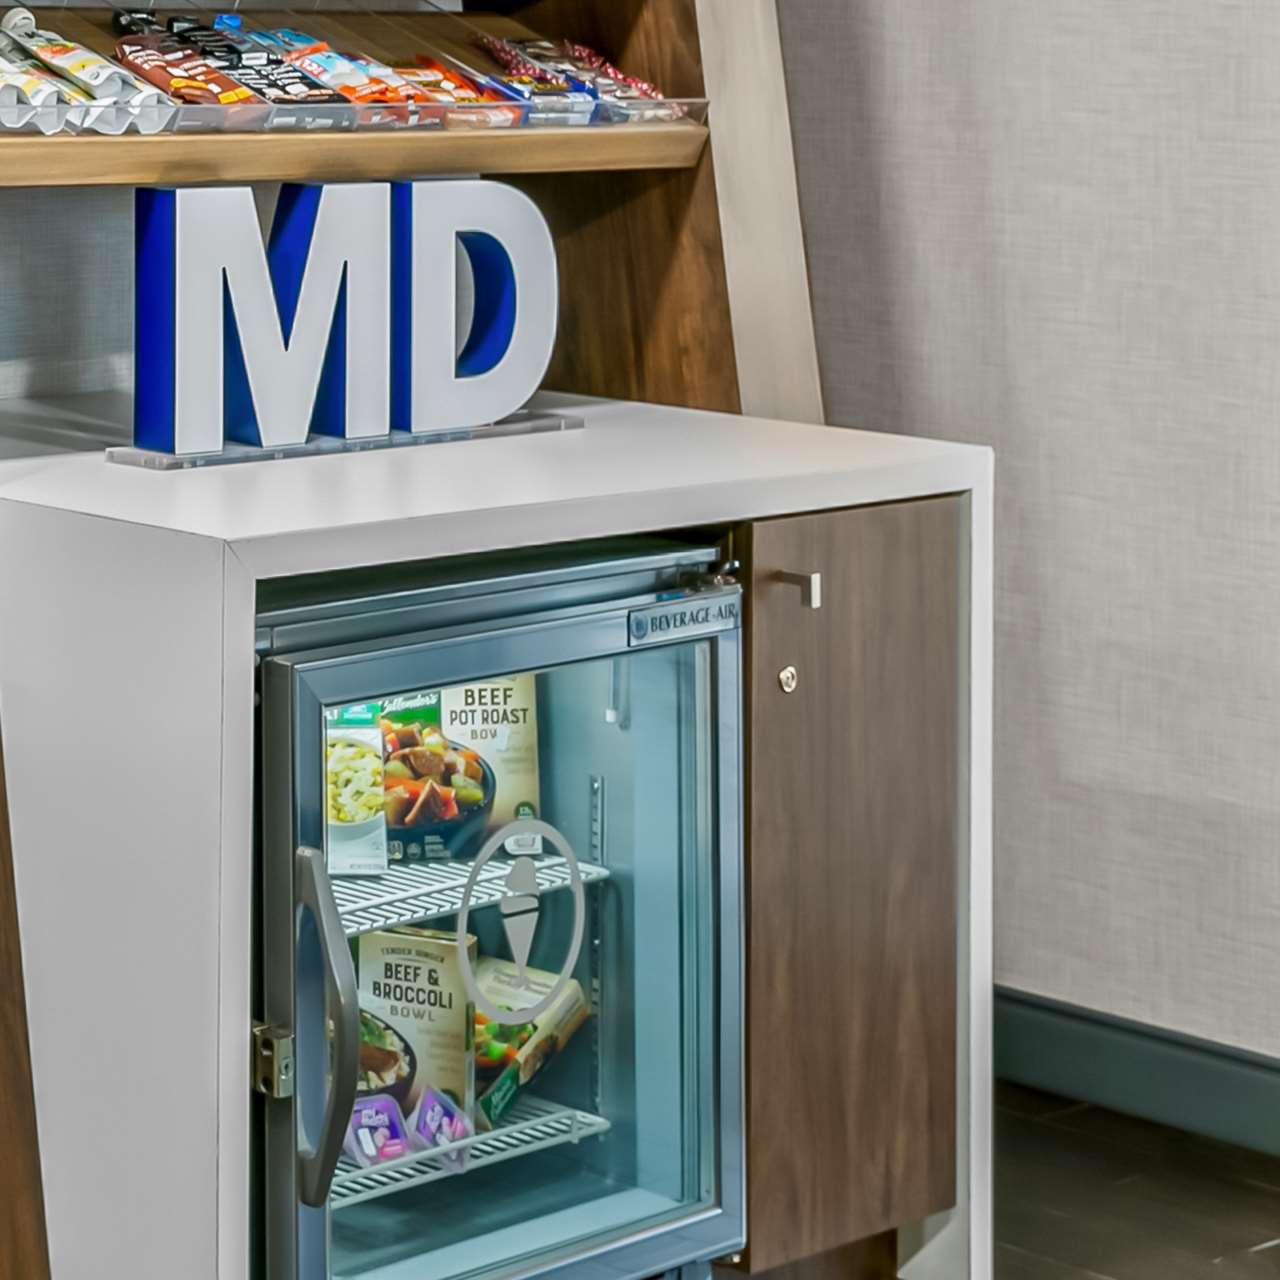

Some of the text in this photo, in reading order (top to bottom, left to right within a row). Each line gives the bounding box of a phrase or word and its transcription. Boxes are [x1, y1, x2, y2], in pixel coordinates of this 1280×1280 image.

[175, 179, 559, 456] MD
[650, 602, 737, 633] BEVERAGE-AIR
[463, 687, 514, 707] BEEF
[449, 708, 529, 726] POT ROAST
[470, 728, 498, 741] BO
[383, 961, 441, 987] BEEF &
[372, 981, 454, 1010] BROCCOLI
[389, 1004, 437, 1022] BOWL
